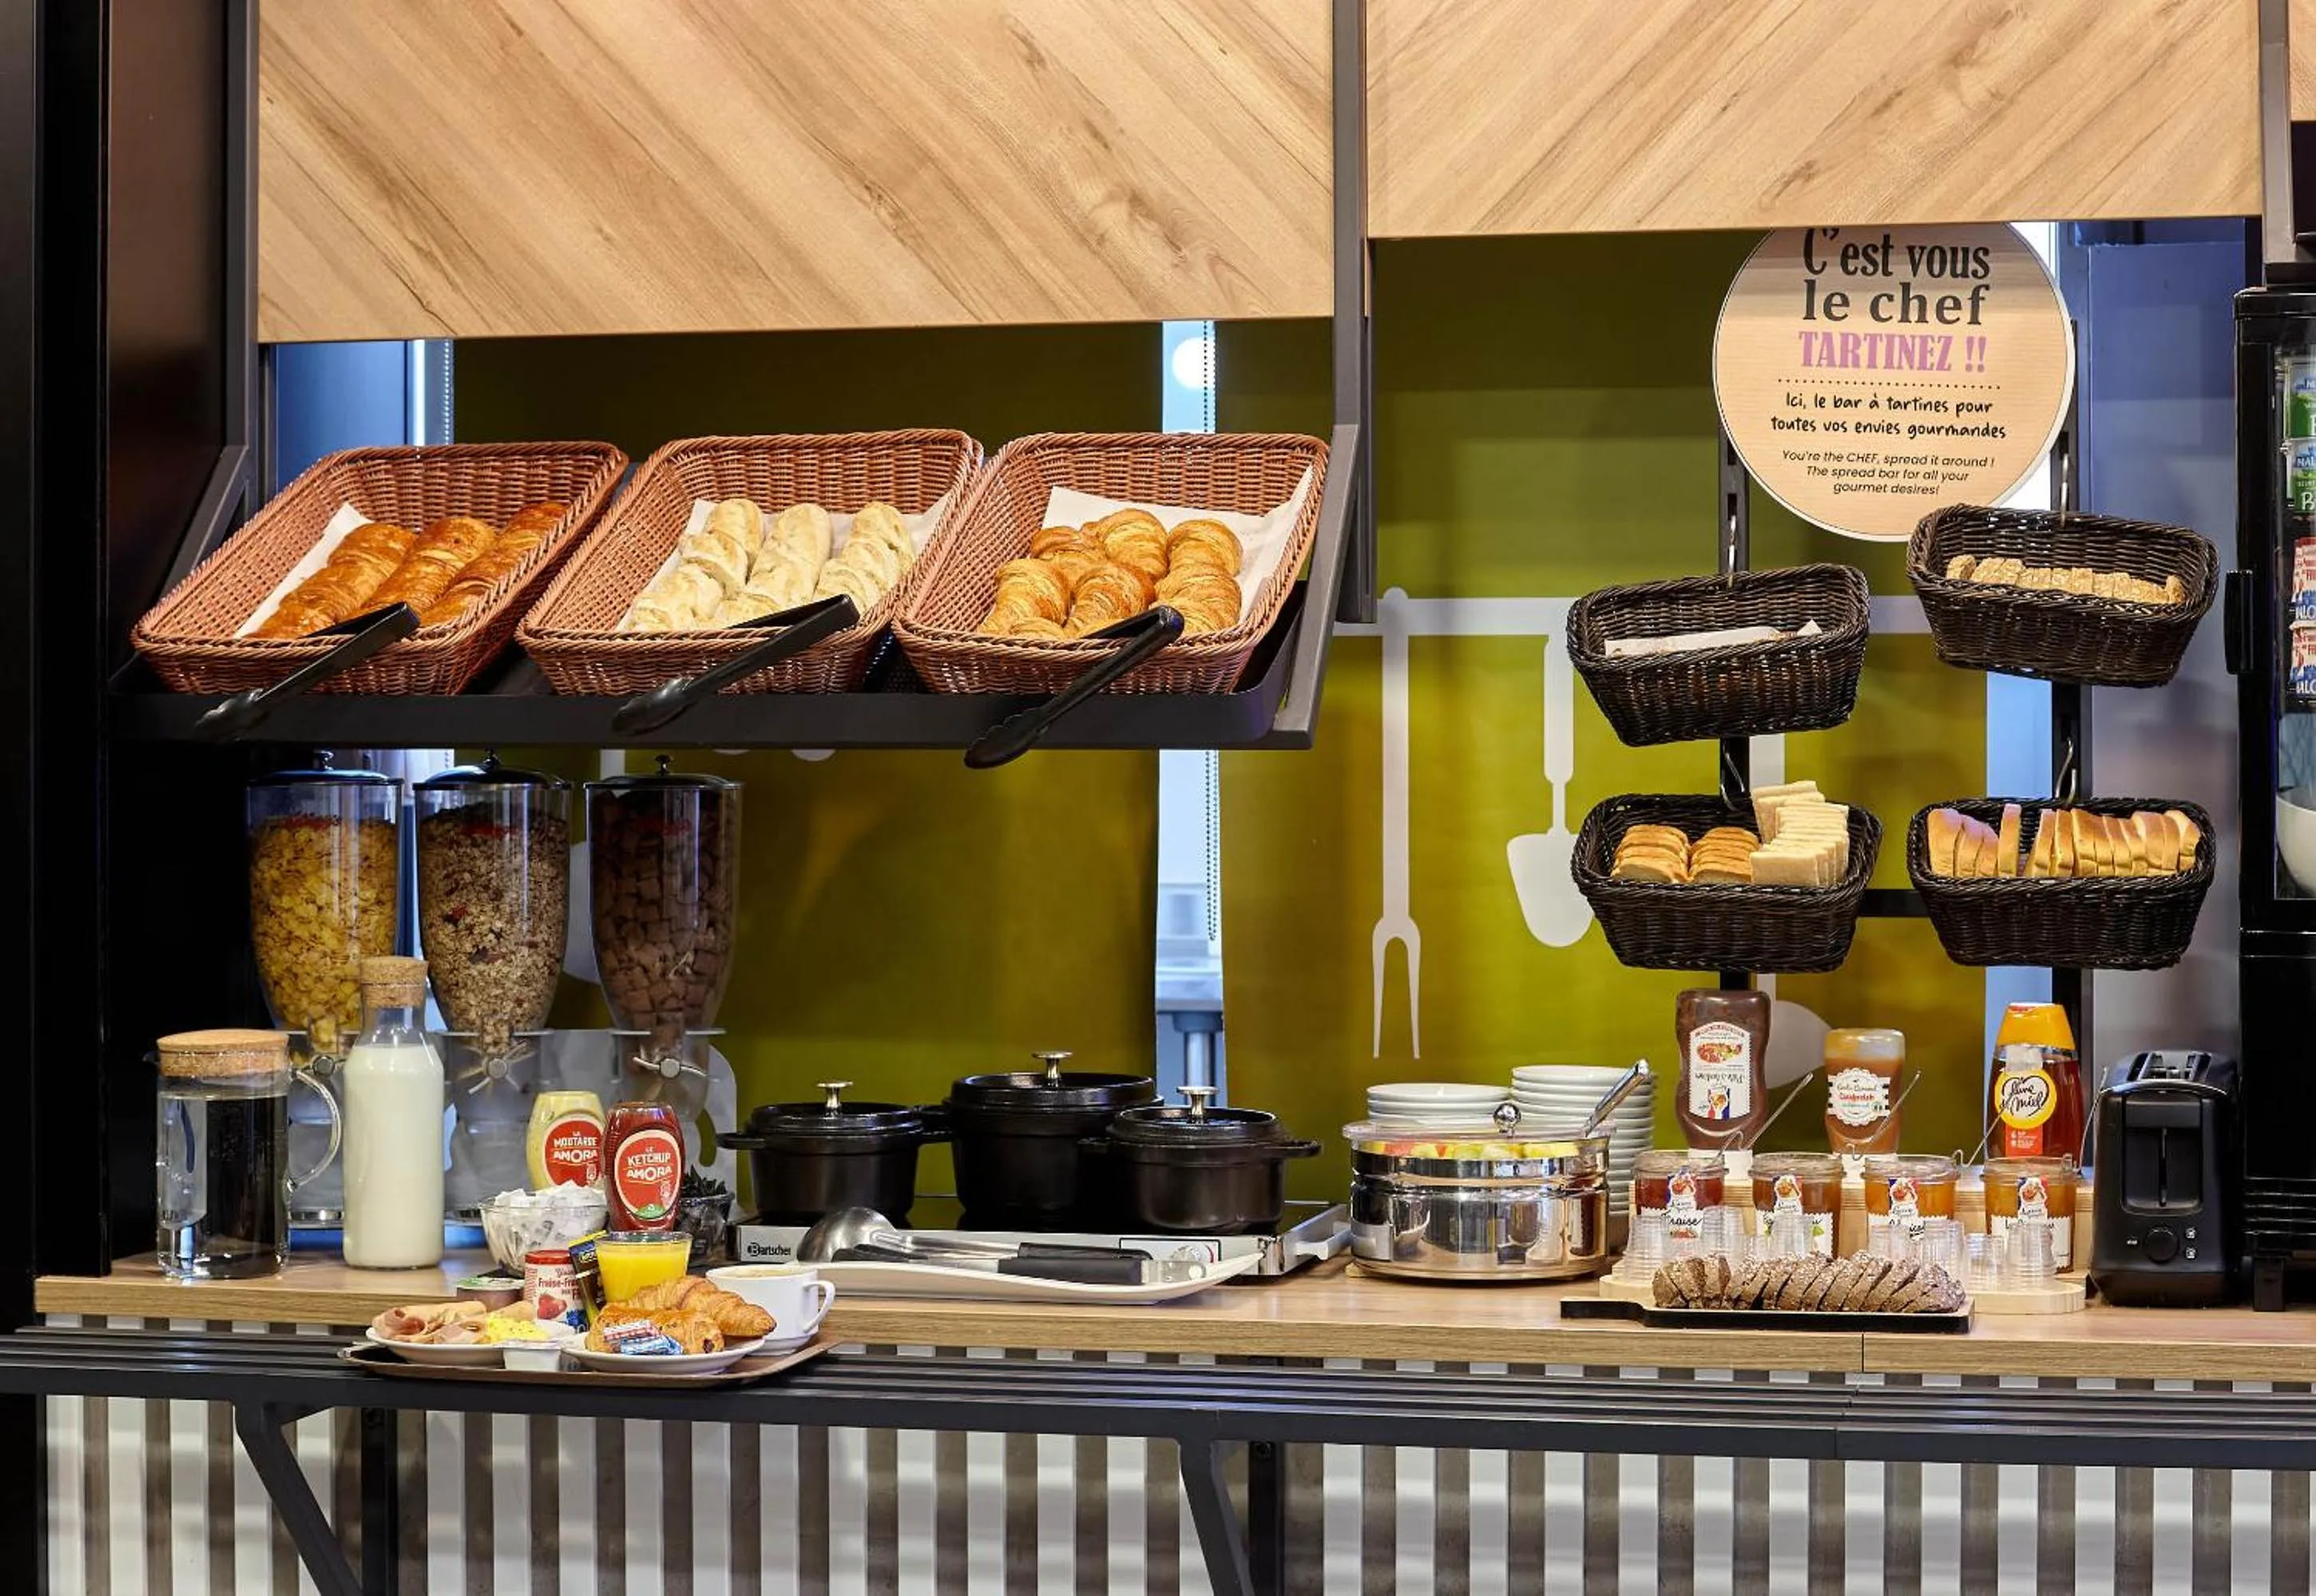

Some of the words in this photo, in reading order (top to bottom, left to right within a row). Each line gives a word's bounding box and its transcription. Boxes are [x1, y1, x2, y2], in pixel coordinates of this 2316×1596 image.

[1802, 228, 1894, 276] C'est
[1906, 245, 1990, 279] vous
[1802, 279, 1850, 321] le
[1870, 282, 1990, 324] chef
[1798, 331, 1953, 371] TARTINEZ
[1965, 336, 1987, 372] !!
[1786, 392, 1806, 409] Ici,
[1814, 394, 1826, 408] le
[1834, 394, 1862, 408] bar
[1869, 394, 1878, 409] à
[1886, 396, 1949, 412] tartines
[1956, 402, 1993, 417] pour
[1771, 416, 1816, 432] toutes
[1823, 421, 1847, 433] vos
[1855, 419, 1900, 434] envies
[1908, 422, 2006, 439] gourmandes
[1783, 449, 1821, 461] You're
[1823, 451, 1843, 462] the
[1883, 454, 1928, 466] spread
[1930, 454, 1939, 465] it
[1941, 457, 1988, 467] around
[1806, 465, 1828, 476] The
[1831, 467, 1875, 479] spread
[1878, 469, 1900, 478] bar
[1903, 469, 1920, 479] for
[1922, 469, 1938, 481] all
[1941, 472, 1969, 483] your
[1834, 482, 1888, 494] gourmet
[553, 1150, 598, 1163] AMORA
[628, 1152, 671, 1166] KETCHUP
[626, 1166, 672, 1181] AMORA
[747, 1242, 791, 1257] Bartscher
